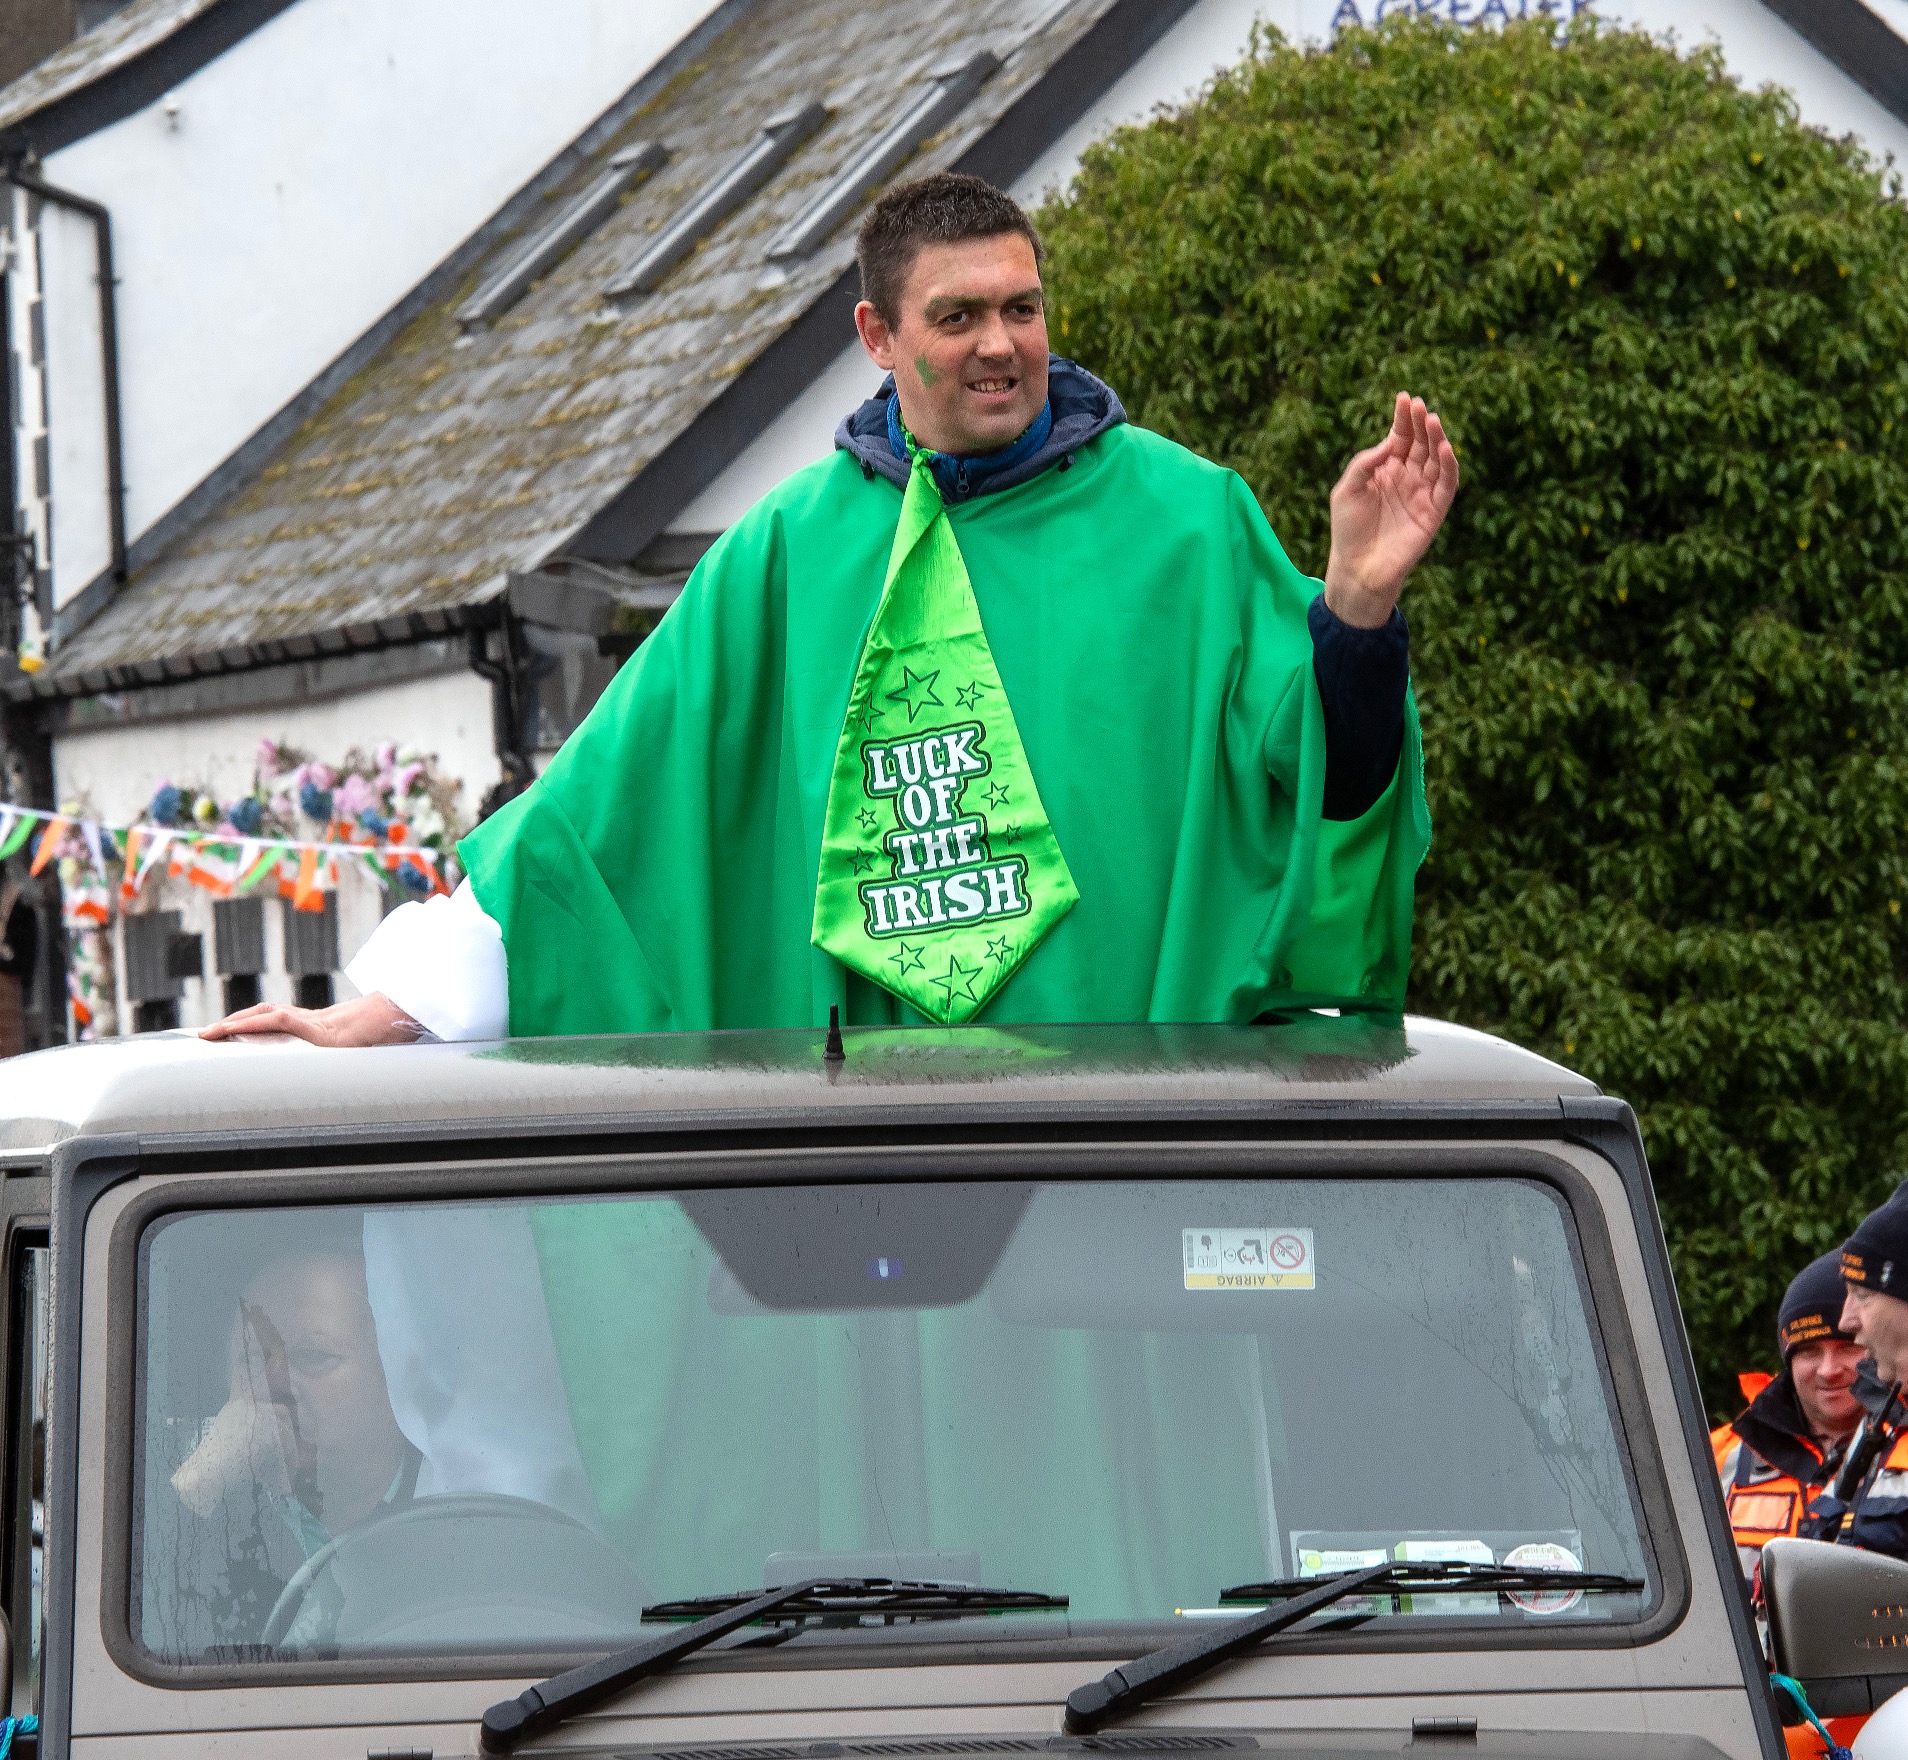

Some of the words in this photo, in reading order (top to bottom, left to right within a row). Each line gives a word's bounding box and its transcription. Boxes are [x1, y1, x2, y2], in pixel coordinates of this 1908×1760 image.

[867, 729, 982, 790] LUCK
[903, 776, 958, 827] OF
[892, 821, 982, 875] THE
[866, 863, 1022, 932] IRISH
[1217, 1275, 1266, 1286] AIRBAG
